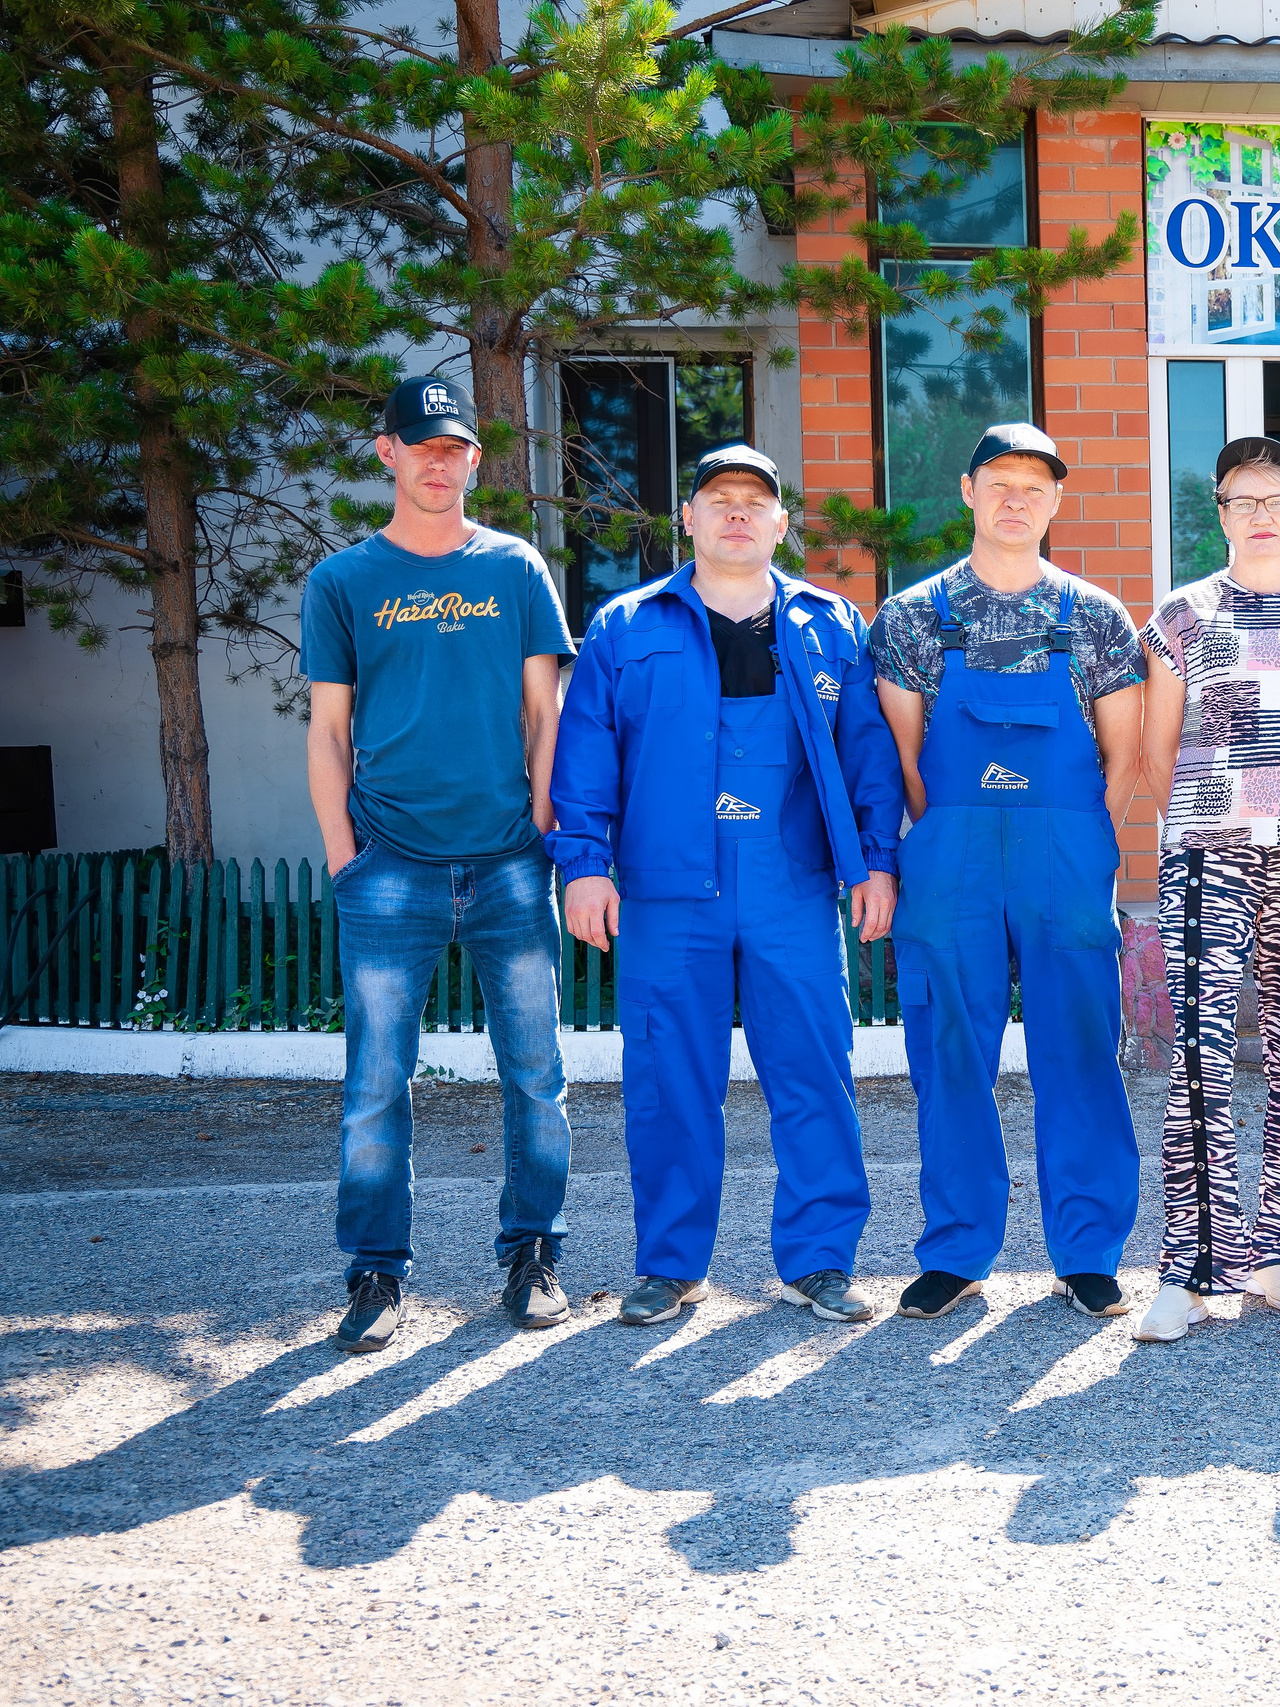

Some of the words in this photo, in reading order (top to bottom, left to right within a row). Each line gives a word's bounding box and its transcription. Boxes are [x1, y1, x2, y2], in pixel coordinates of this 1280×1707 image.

[427, 402, 459, 415] Okna
[437, 621, 465, 633] Baku
[984, 765, 1016, 781] FK
[715, 795, 747, 811] FK
